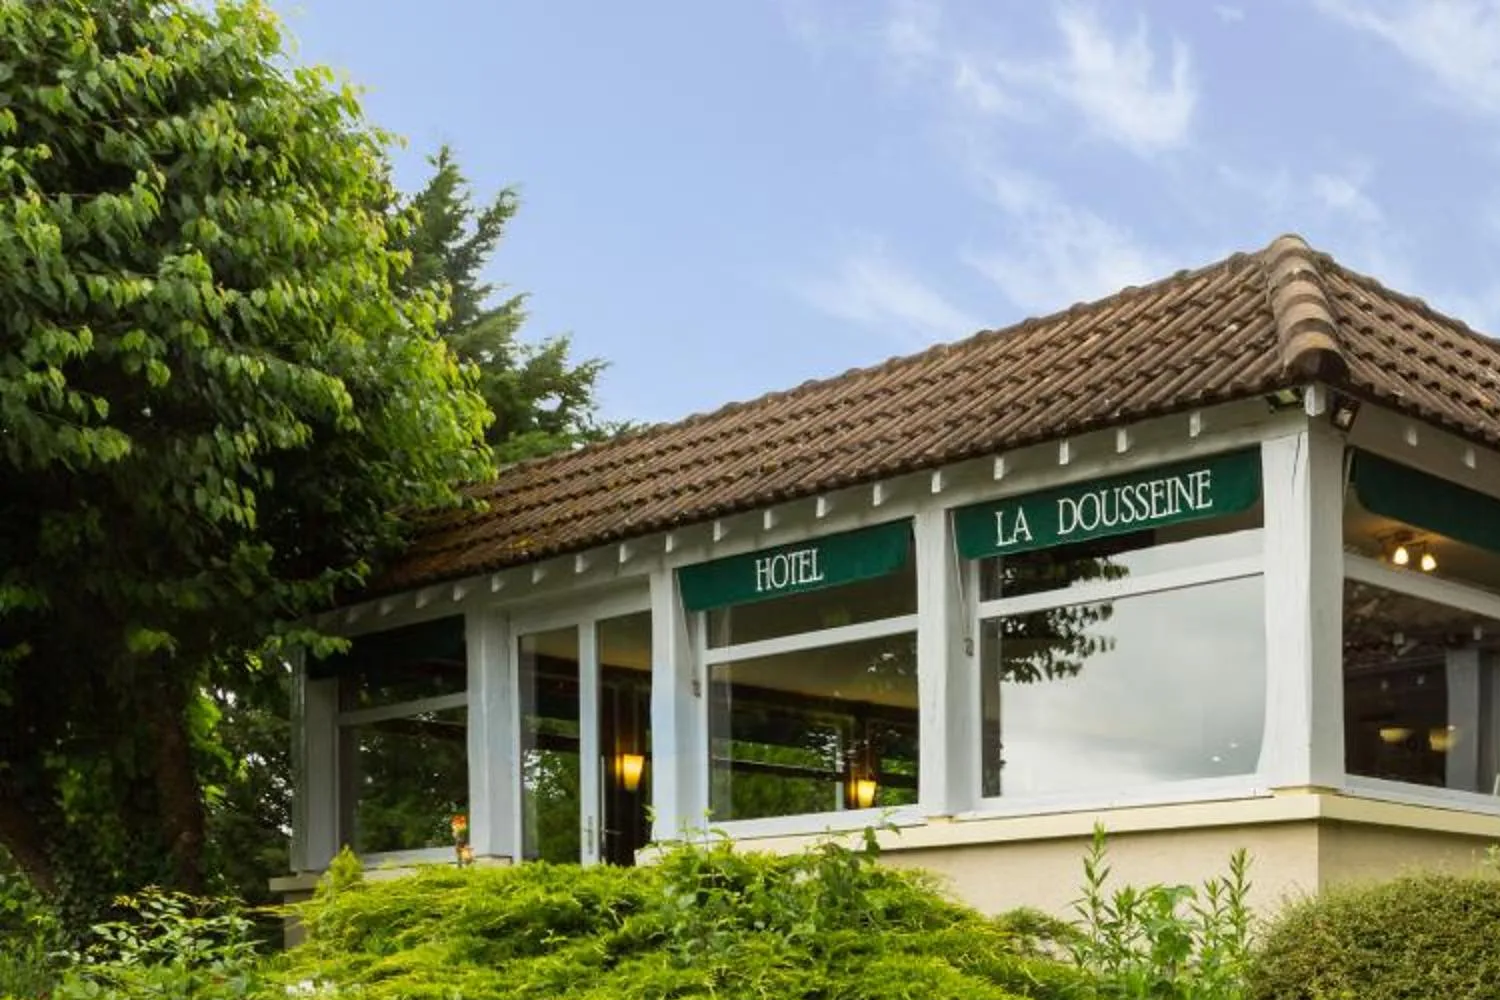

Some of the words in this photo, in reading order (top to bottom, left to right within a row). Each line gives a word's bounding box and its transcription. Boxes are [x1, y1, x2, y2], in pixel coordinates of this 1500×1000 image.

[995, 506, 1033, 547] LA
[1057, 469, 1213, 535] DOUSSEINE
[755, 548, 825, 592] HOTEL
